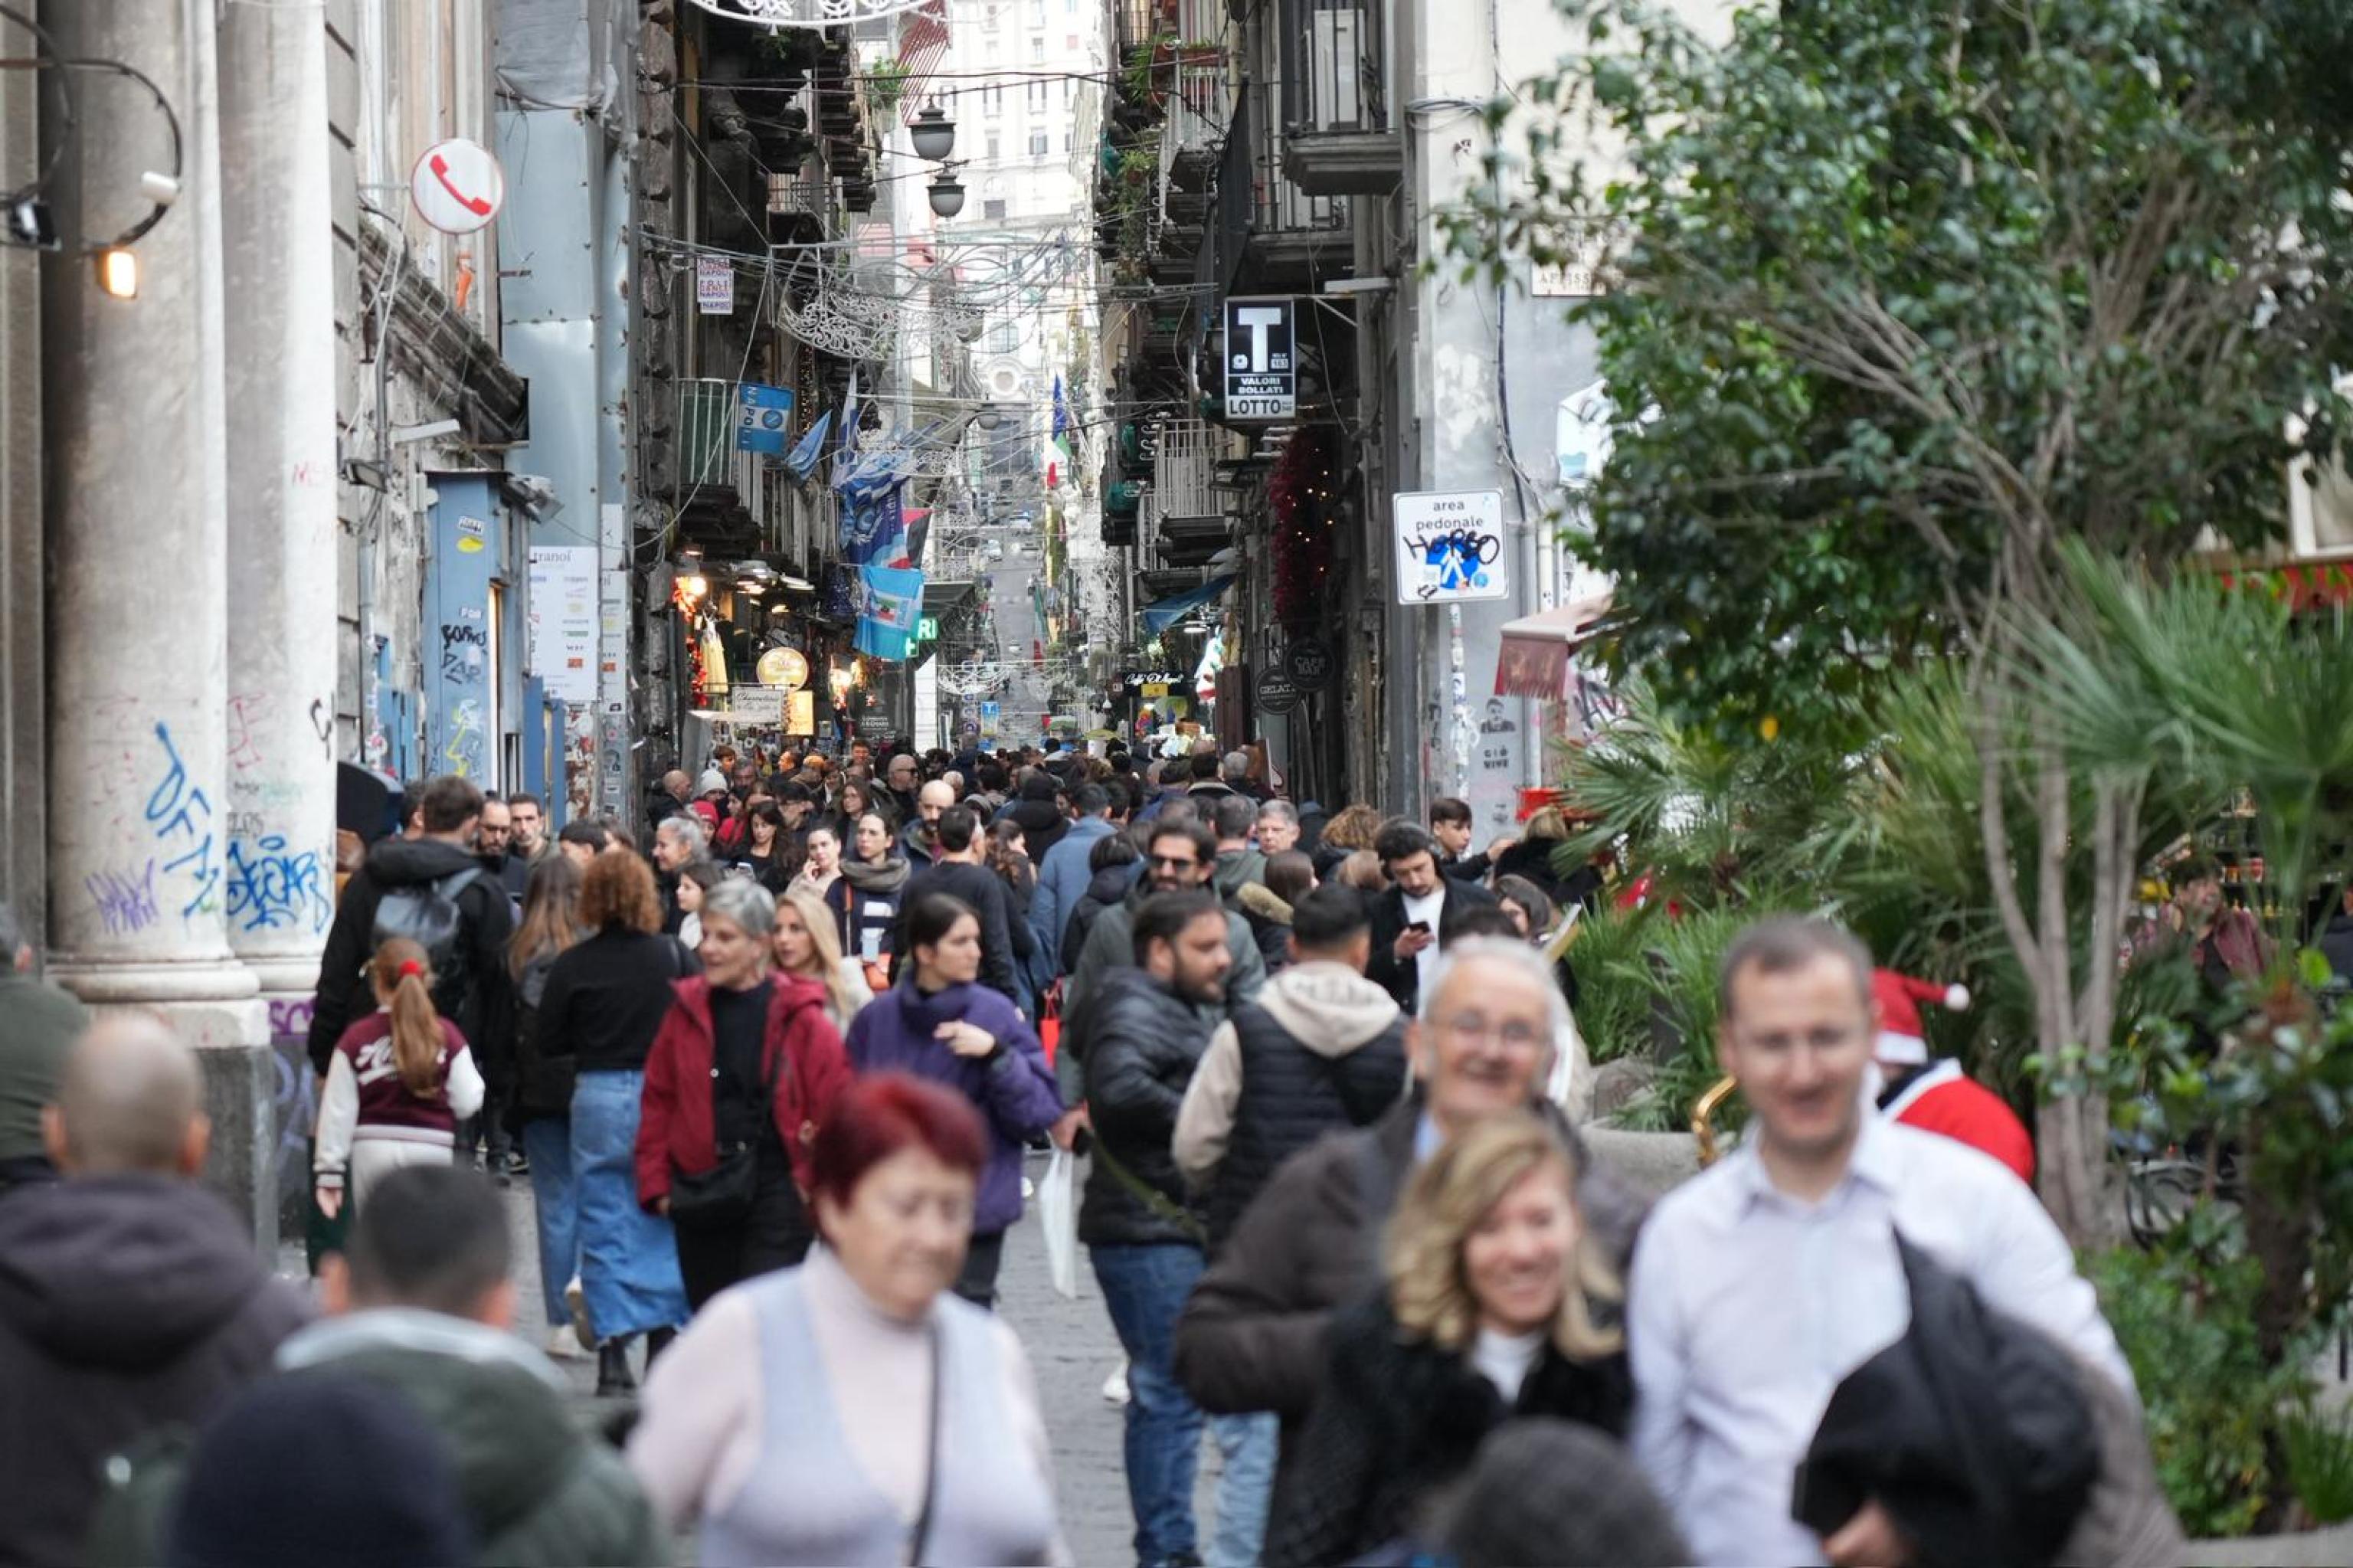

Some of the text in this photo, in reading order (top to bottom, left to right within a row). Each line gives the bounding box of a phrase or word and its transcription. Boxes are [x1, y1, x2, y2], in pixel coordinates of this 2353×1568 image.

[1238, 307, 1282, 373] T
[1240, 377, 1281, 385] VALORI
[1237, 386, 1284, 394] BOLLATI
[1229, 399, 1281, 414] LOTTO
[740, 385, 757, 444] NAPOLI
[1433, 501, 1465, 512] area
[1415, 515, 1484, 532] pedonale
[1259, 684, 1296, 694] GELAT
